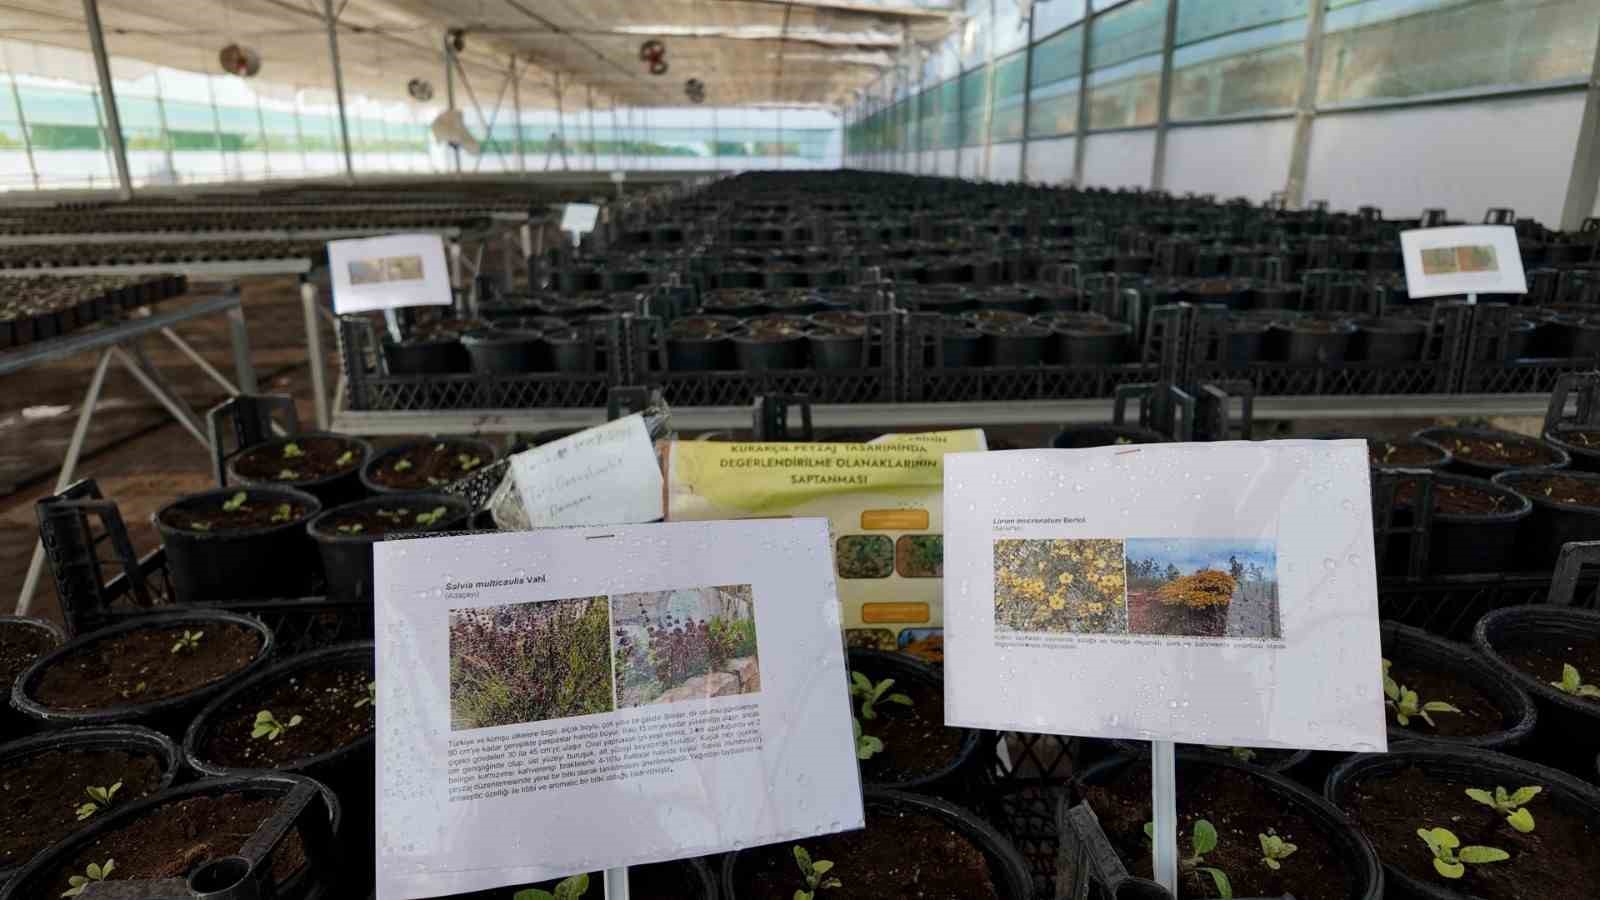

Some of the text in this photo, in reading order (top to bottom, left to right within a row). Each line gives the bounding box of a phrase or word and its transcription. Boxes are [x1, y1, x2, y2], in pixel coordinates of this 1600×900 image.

[791, 473, 869, 486] SAPTANMASI
[445, 582, 473, 591] Salvia
[475, 577, 524, 589] multicaulis
